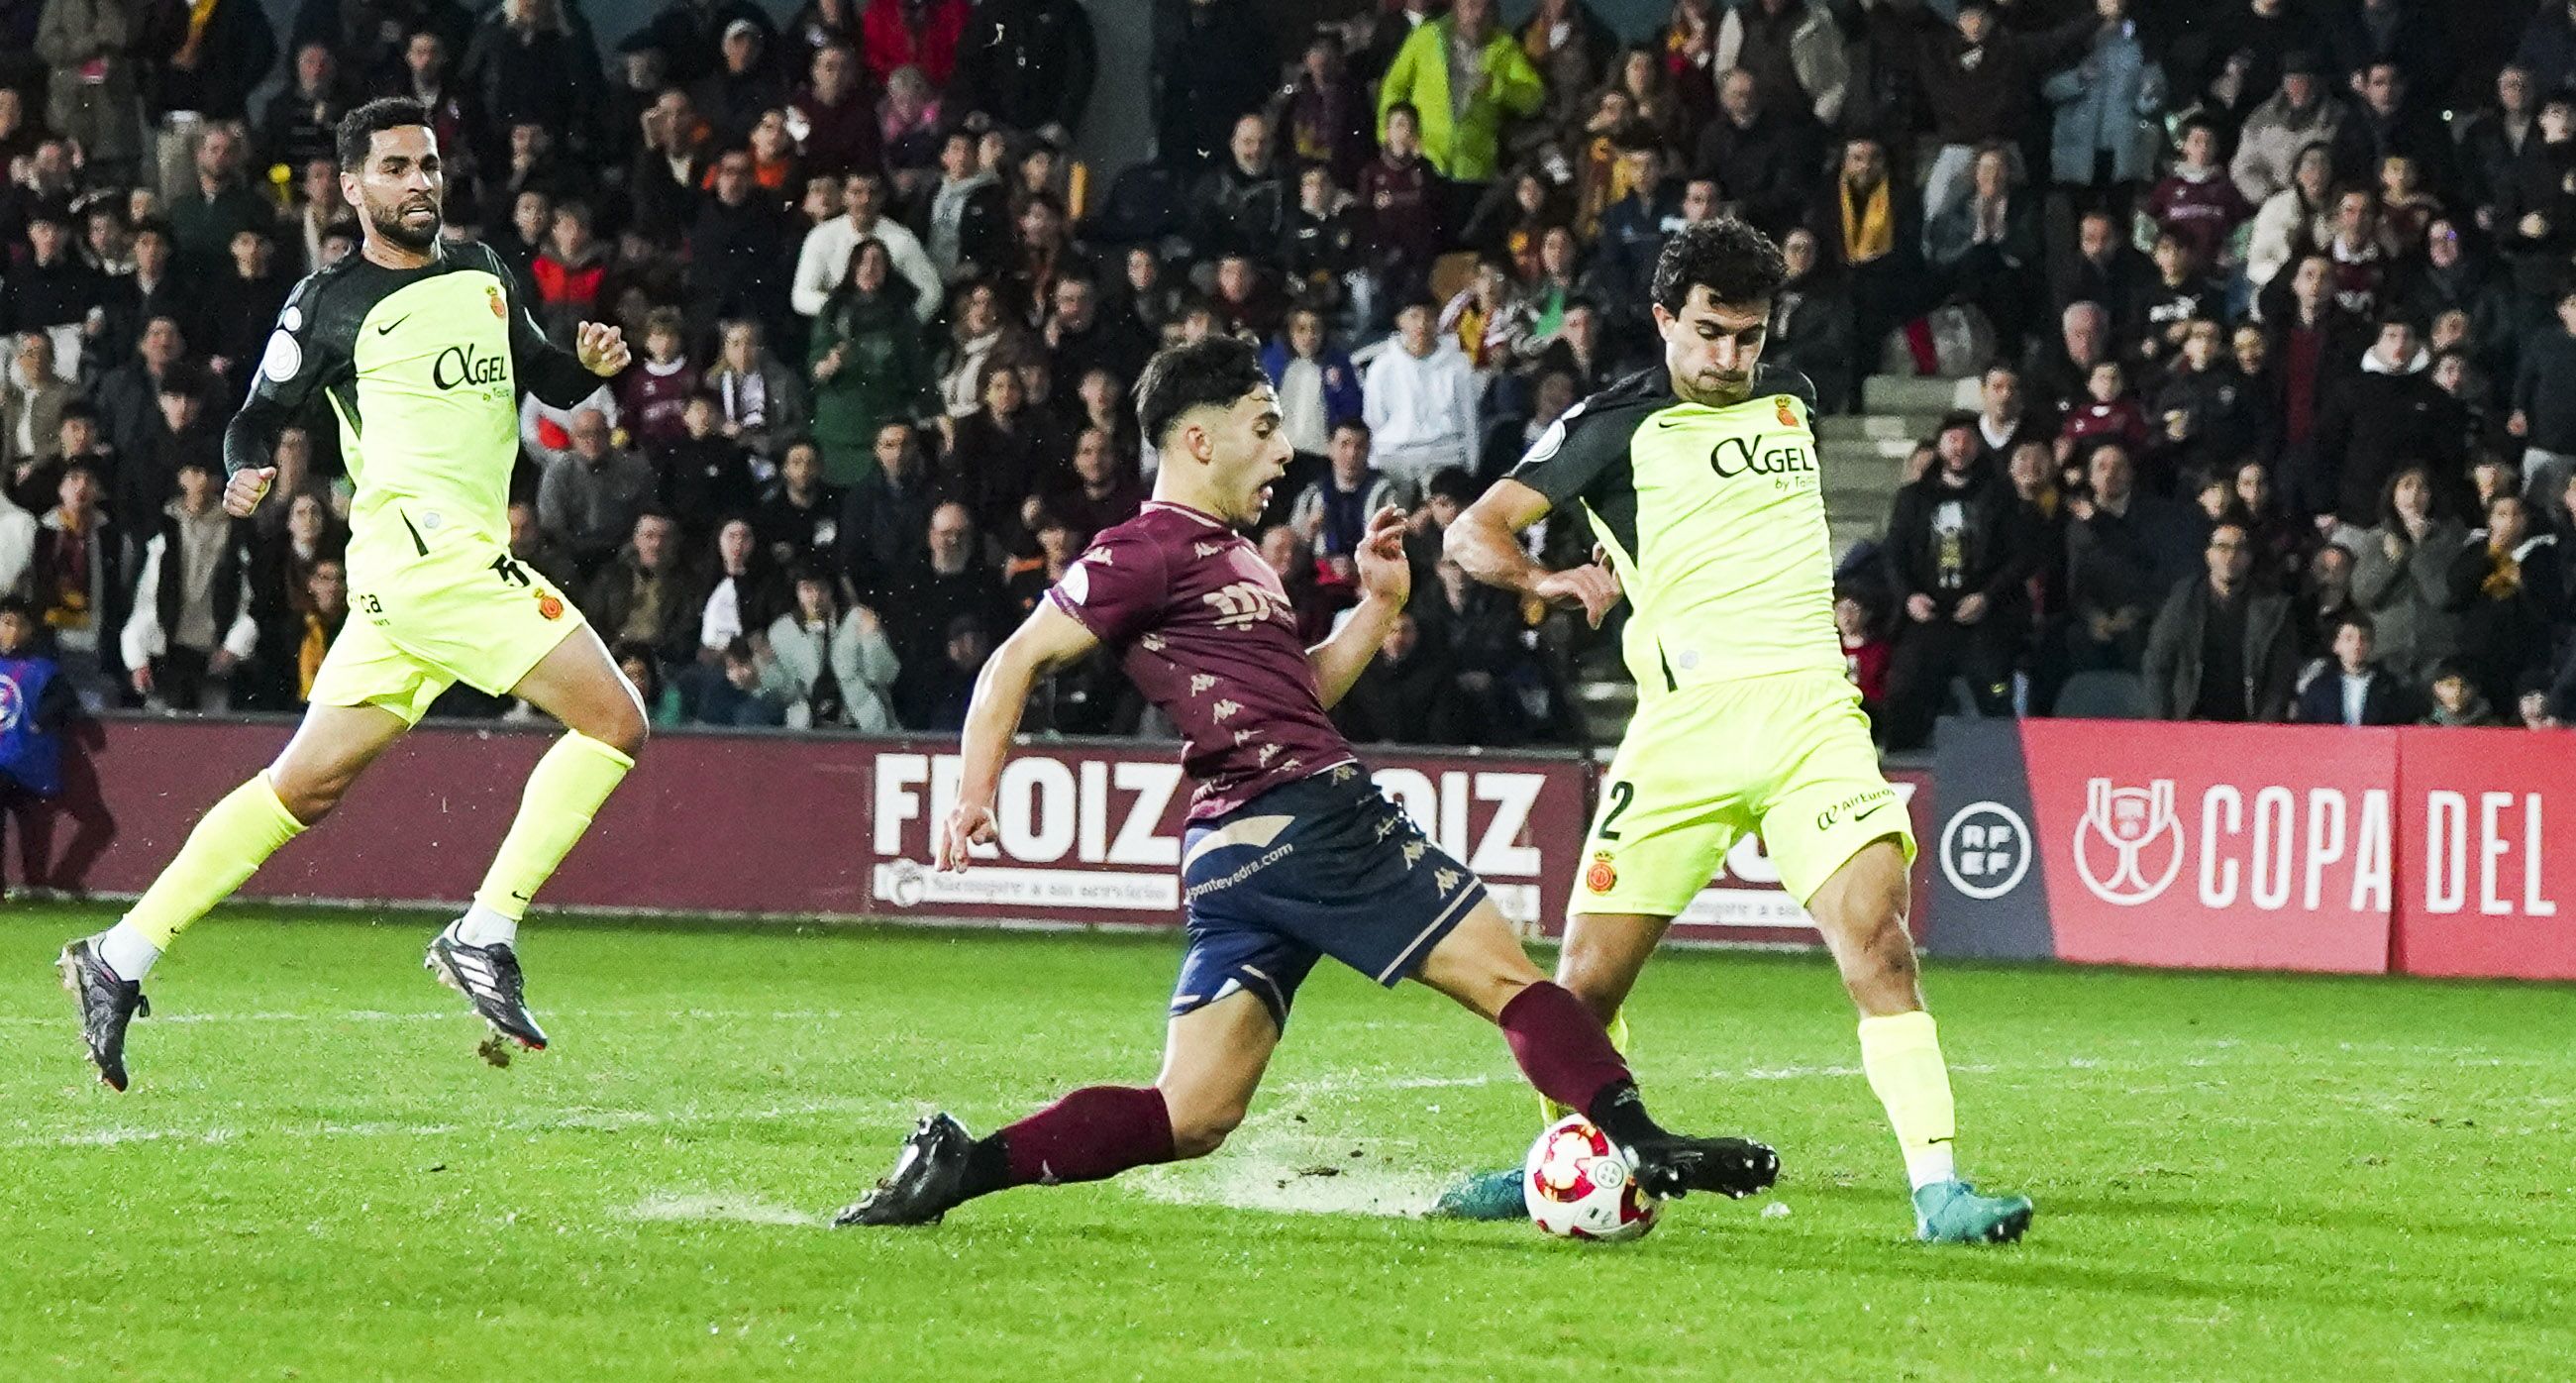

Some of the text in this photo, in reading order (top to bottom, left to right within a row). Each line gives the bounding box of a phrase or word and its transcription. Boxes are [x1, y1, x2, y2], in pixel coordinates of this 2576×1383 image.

[1598, 781, 1634, 841] 2
[2198, 784, 2558, 917] COPA DEL
